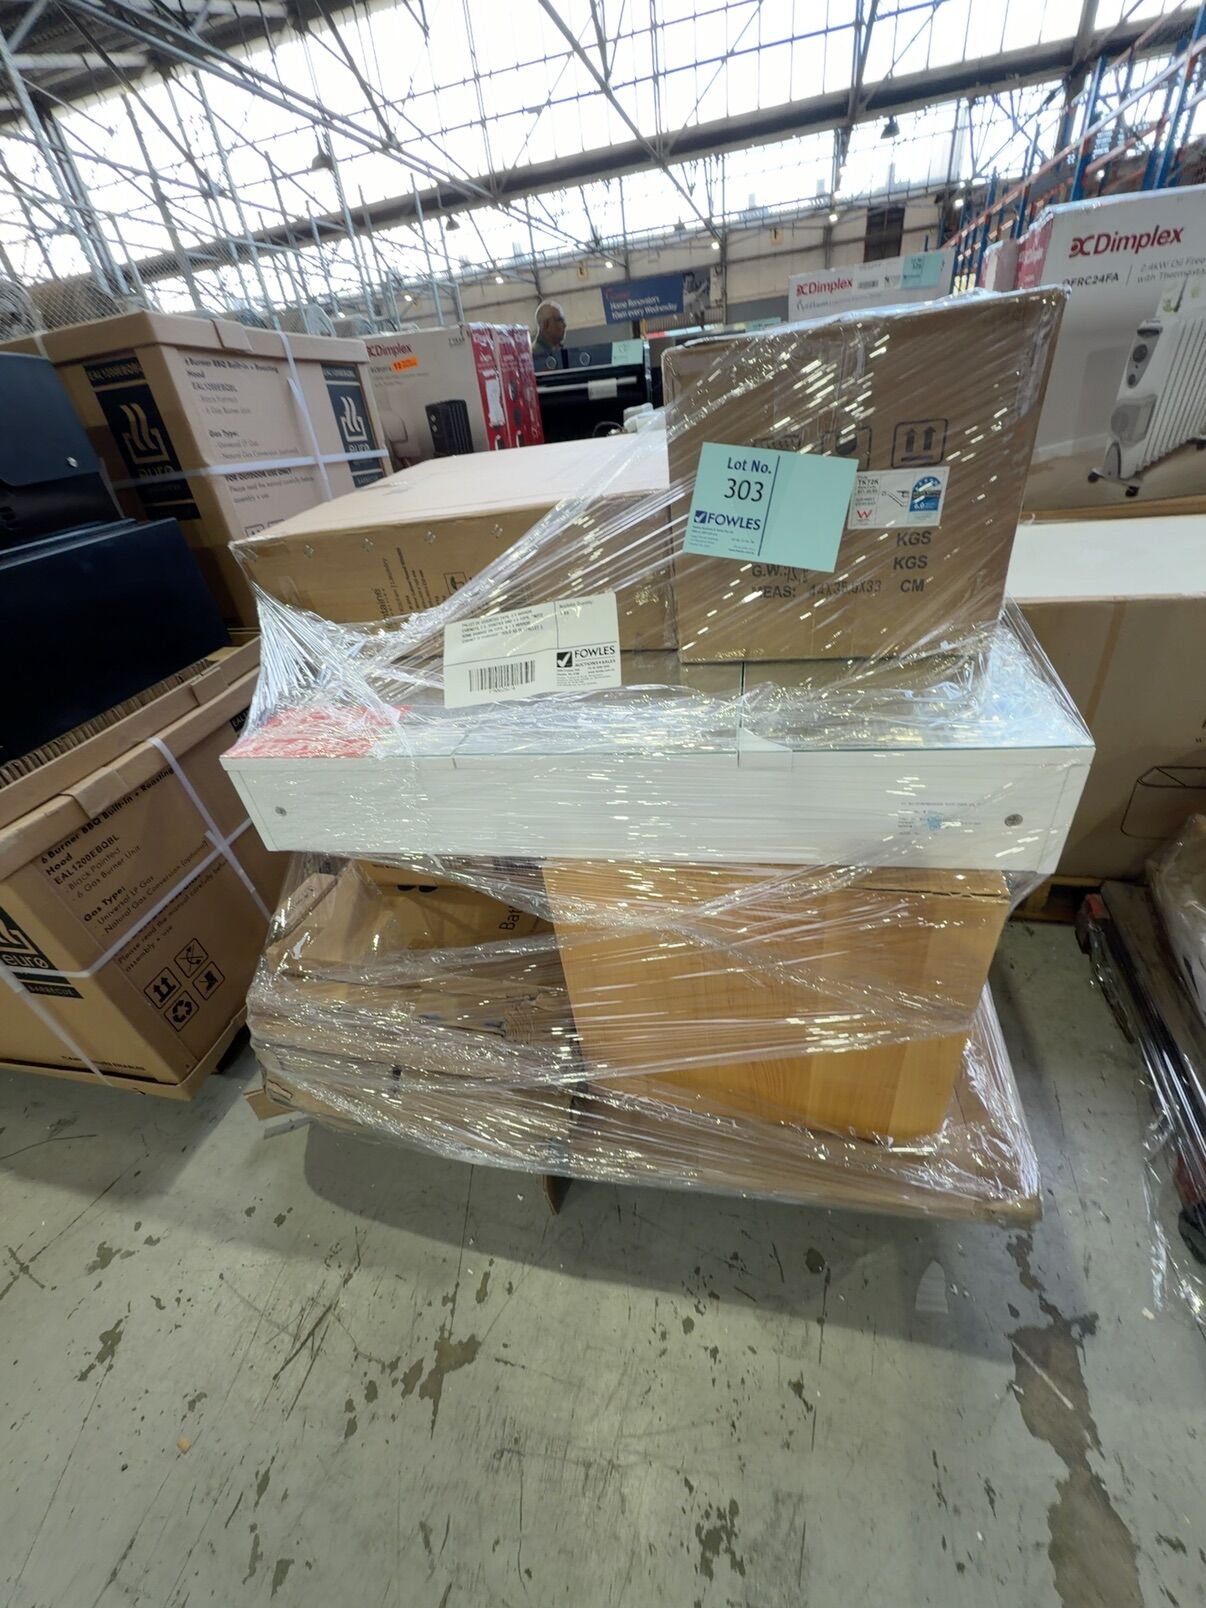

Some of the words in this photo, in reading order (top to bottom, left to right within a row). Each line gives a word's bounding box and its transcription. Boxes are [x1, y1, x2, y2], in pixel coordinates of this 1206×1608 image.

[1093, 225, 1185, 254] Dimplex
[808, 277, 853, 294] Dimplex
[375, 343, 413, 357] Dimplex
[727, 457, 747, 471] Lot
[751, 460, 772, 475] No.
[724, 478, 765, 502] 303
[707, 512, 761, 531] FOWLES
[896, 531, 932, 547] KGS
[893, 555, 928, 571] KGS
[900, 579, 925, 593] CM
[574, 645, 616, 659] FOWLES
[41, 854, 48, 864] 6
[48, 833, 80, 859] Burner
[81, 816, 102, 835] BBQ
[140, 767, 175, 792] Roasting
[45, 852, 73, 876] Hood
[67, 871, 92, 891] Black
[91, 847, 122, 873] Painted
[84, 877, 101, 892] Gas
[101, 857, 126, 879] Burner
[125, 845, 142, 859] Unit
[84, 906, 102, 922] Gas
[102, 886, 126, 908] Type:
[97, 896, 131, 925] Universal
[139, 875, 155, 888] Gas
[104, 907, 132, 934] Natural
[132, 895, 147, 910] Gas
[146, 865, 181, 896] Conversion
